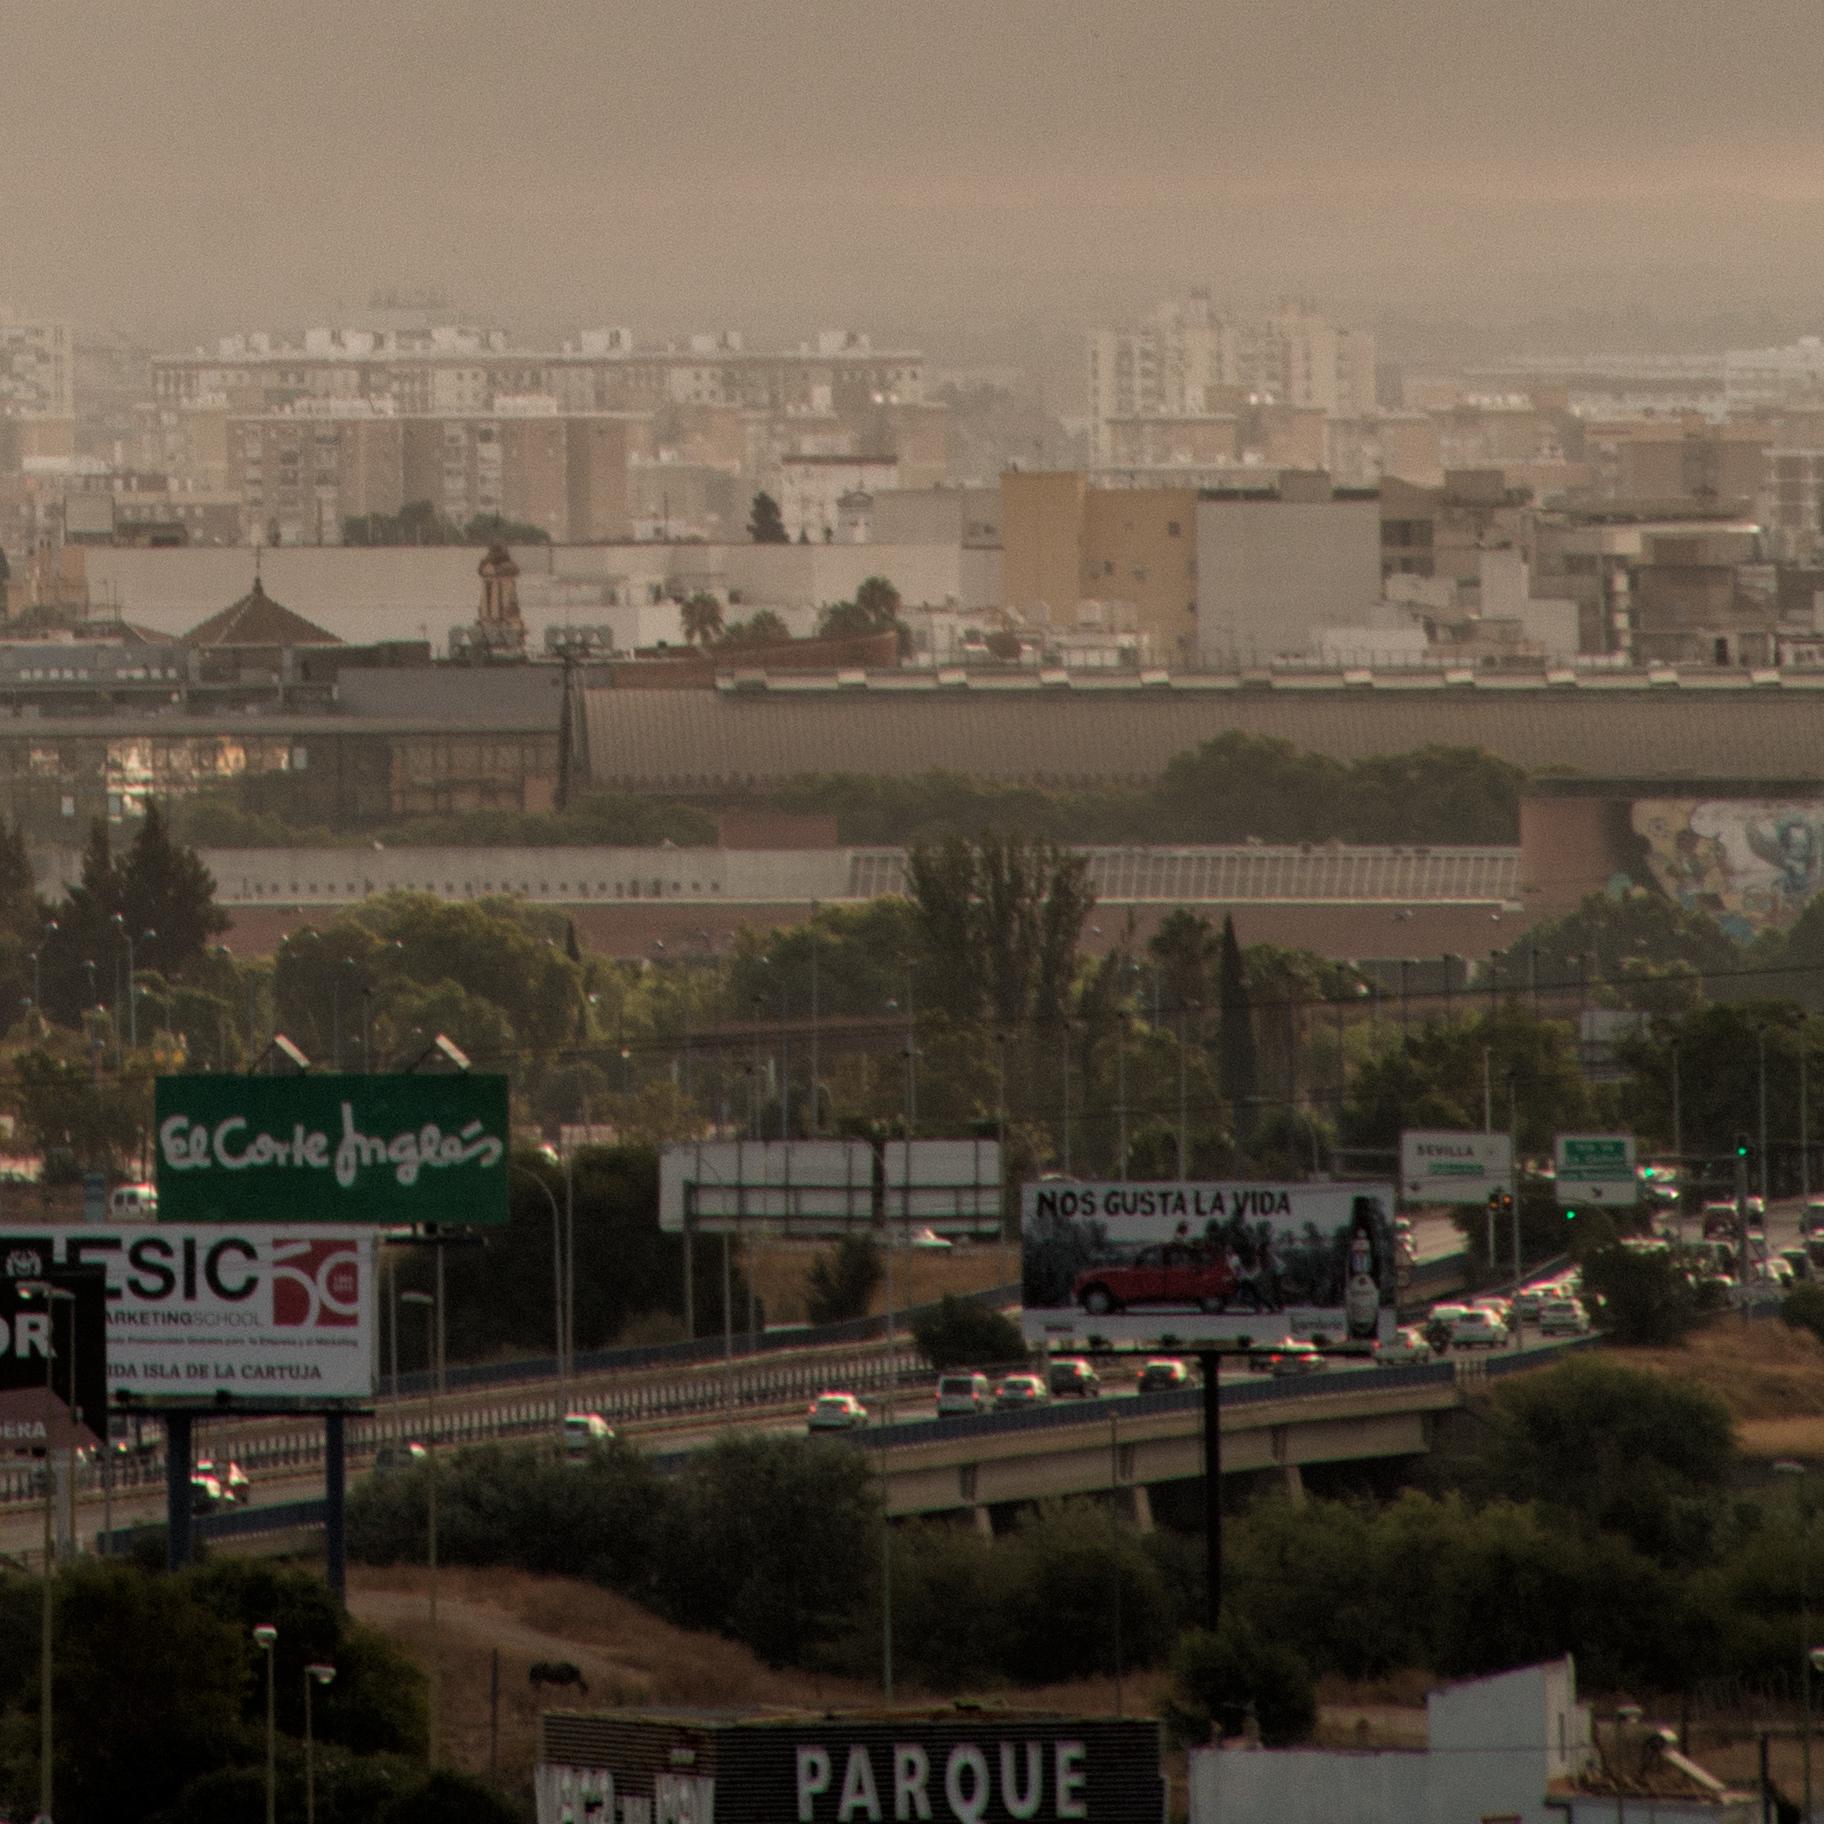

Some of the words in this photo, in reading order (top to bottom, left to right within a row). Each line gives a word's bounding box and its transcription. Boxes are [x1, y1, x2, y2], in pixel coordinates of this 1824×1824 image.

[159, 1113, 212, 1170] El
[213, 1115, 329, 1169] Corte
[1036, 1191, 1096, 1217] NOS
[1103, 1191, 1186, 1216] GUSTA
[1195, 1191, 1226, 1216] LA
[1233, 1191, 1292, 1216] VIDA
[143, 1363, 180, 1378] ISLA
[185, 1364, 209, 1378] DE
[213, 1364, 235, 1378] LA
[240, 1364, 323, 1380] CARTUJA
[796, 1740, 1089, 1824] PARQUE
